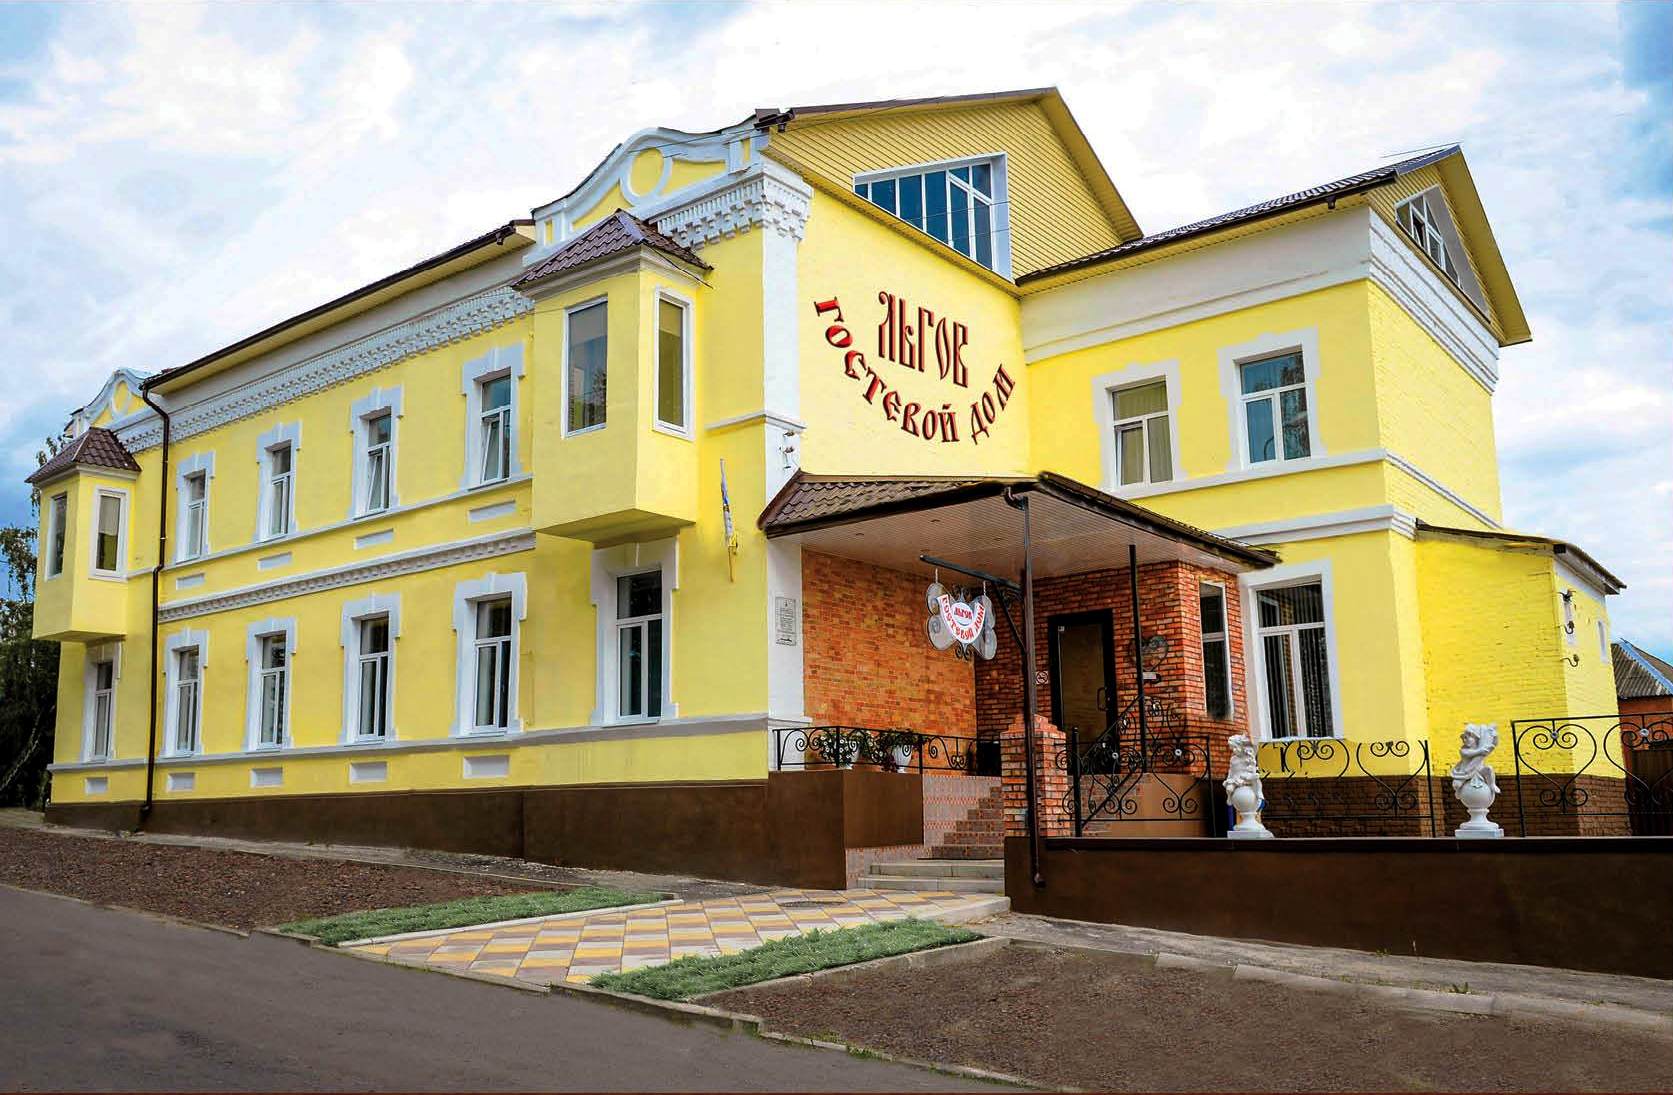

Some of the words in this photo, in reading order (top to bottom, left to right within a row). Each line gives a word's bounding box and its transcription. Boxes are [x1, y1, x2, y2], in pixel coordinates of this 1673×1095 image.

[814, 296, 960, 442] ГОСТЕВОЙ
[970, 364, 1016, 445] ДОМ
[878, 291, 968, 388] ЛЬГОВ
